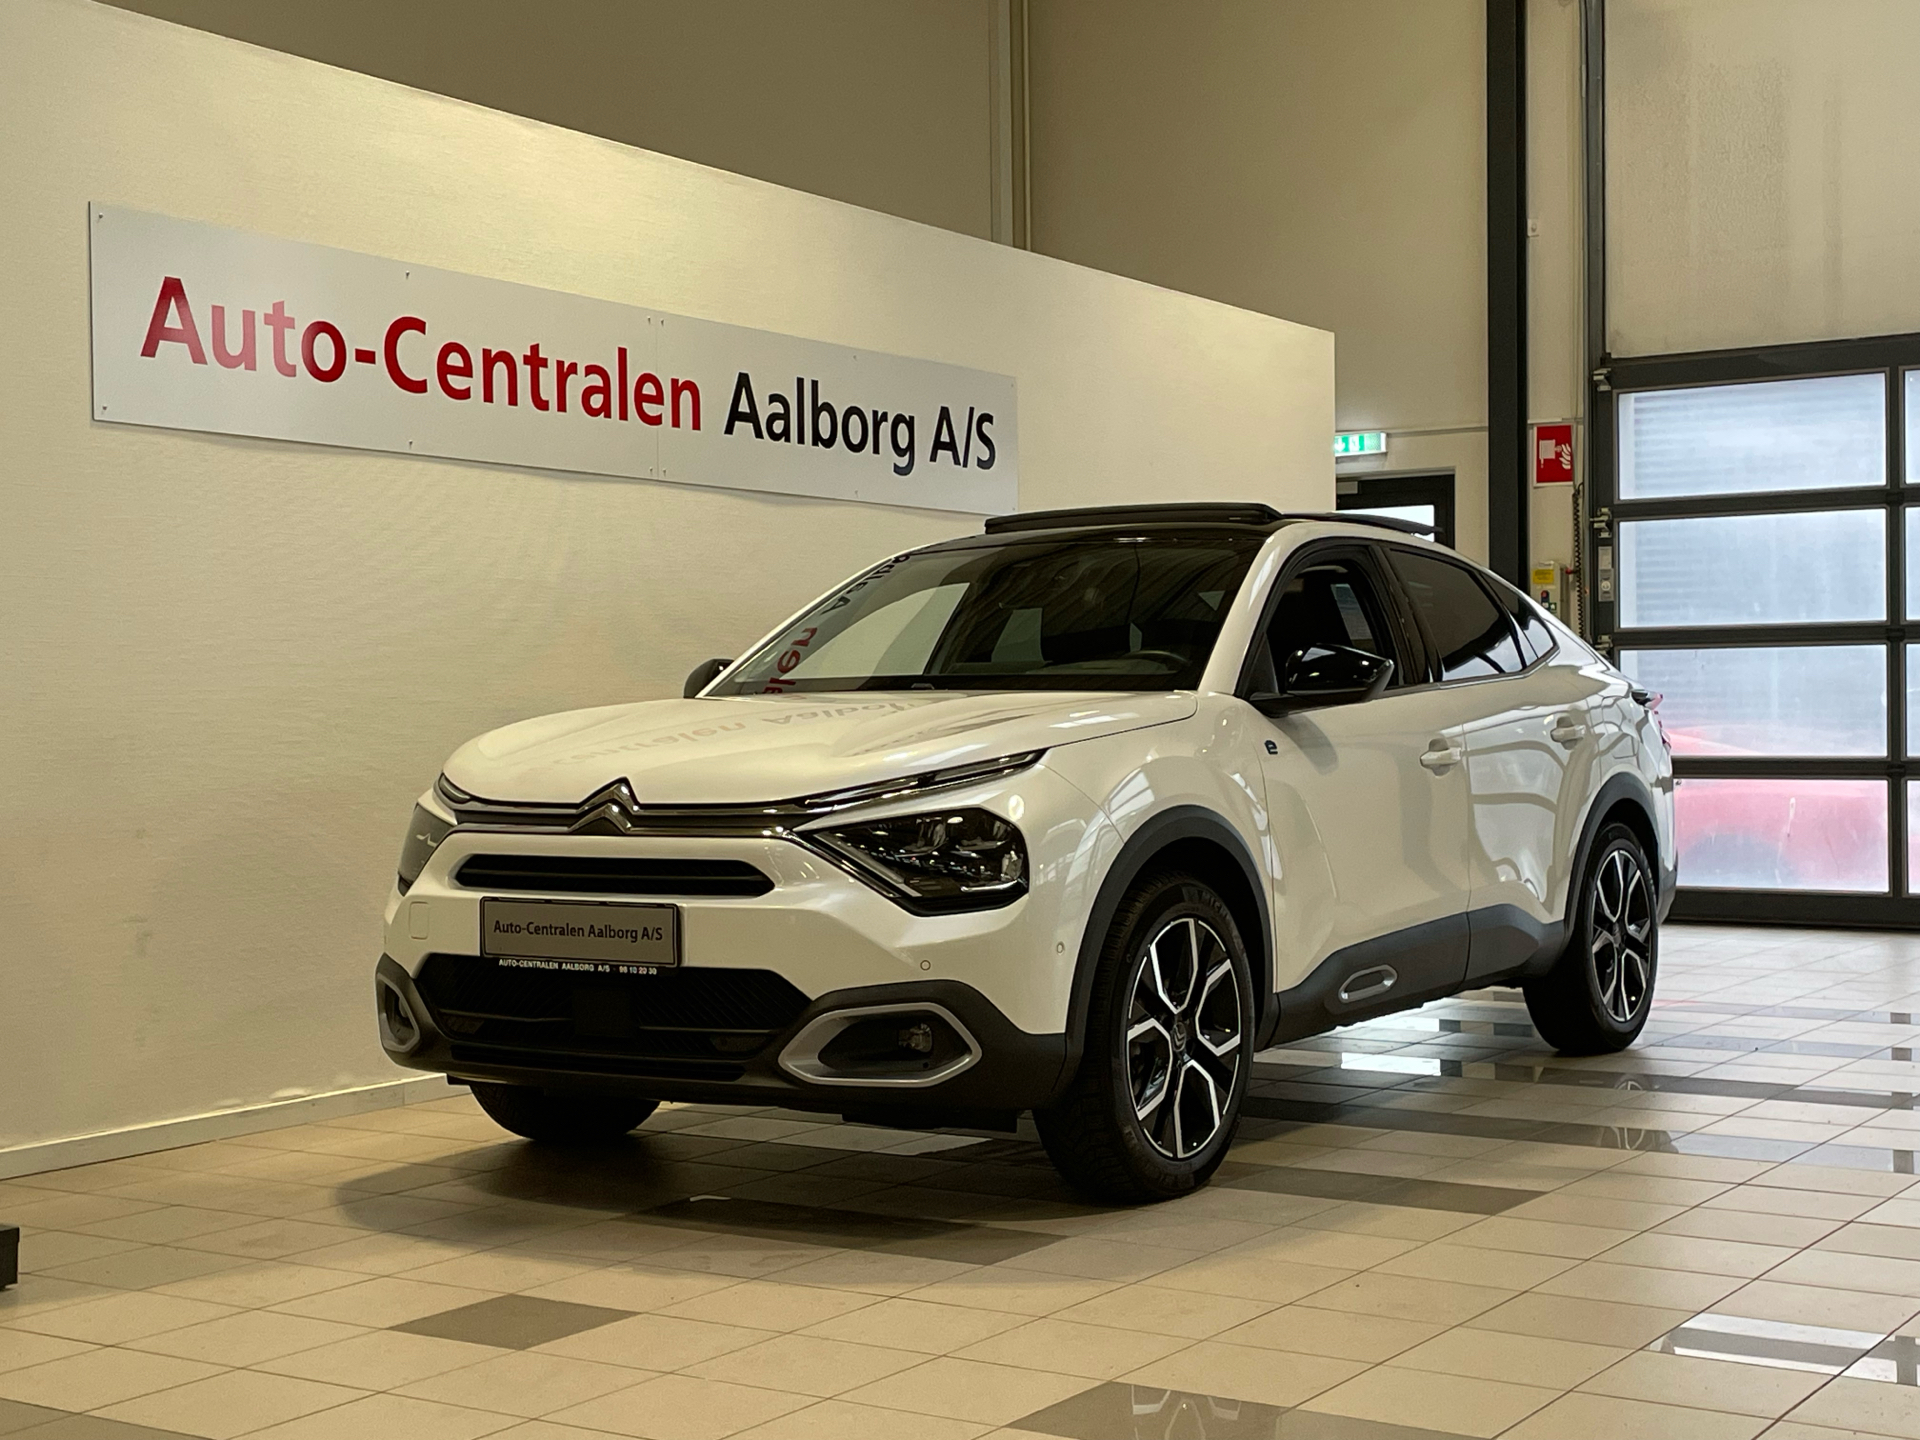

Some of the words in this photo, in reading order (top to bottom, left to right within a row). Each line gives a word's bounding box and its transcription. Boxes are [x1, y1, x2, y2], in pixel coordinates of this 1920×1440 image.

[140, 276, 701, 431] Auto-Centralen
[723, 371, 915, 476] Aalborg
[929, 406, 996, 470] A/S
[493, 920, 585, 937] Auto-Centralen
[587, 924, 638, 943] Aalborg
[641, 926, 663, 941] A/S
[499, 959, 559, 969] AUTO-CENTRALEN
[561, 962, 595, 972] AALBORG
[597, 964, 610, 973] A/S
